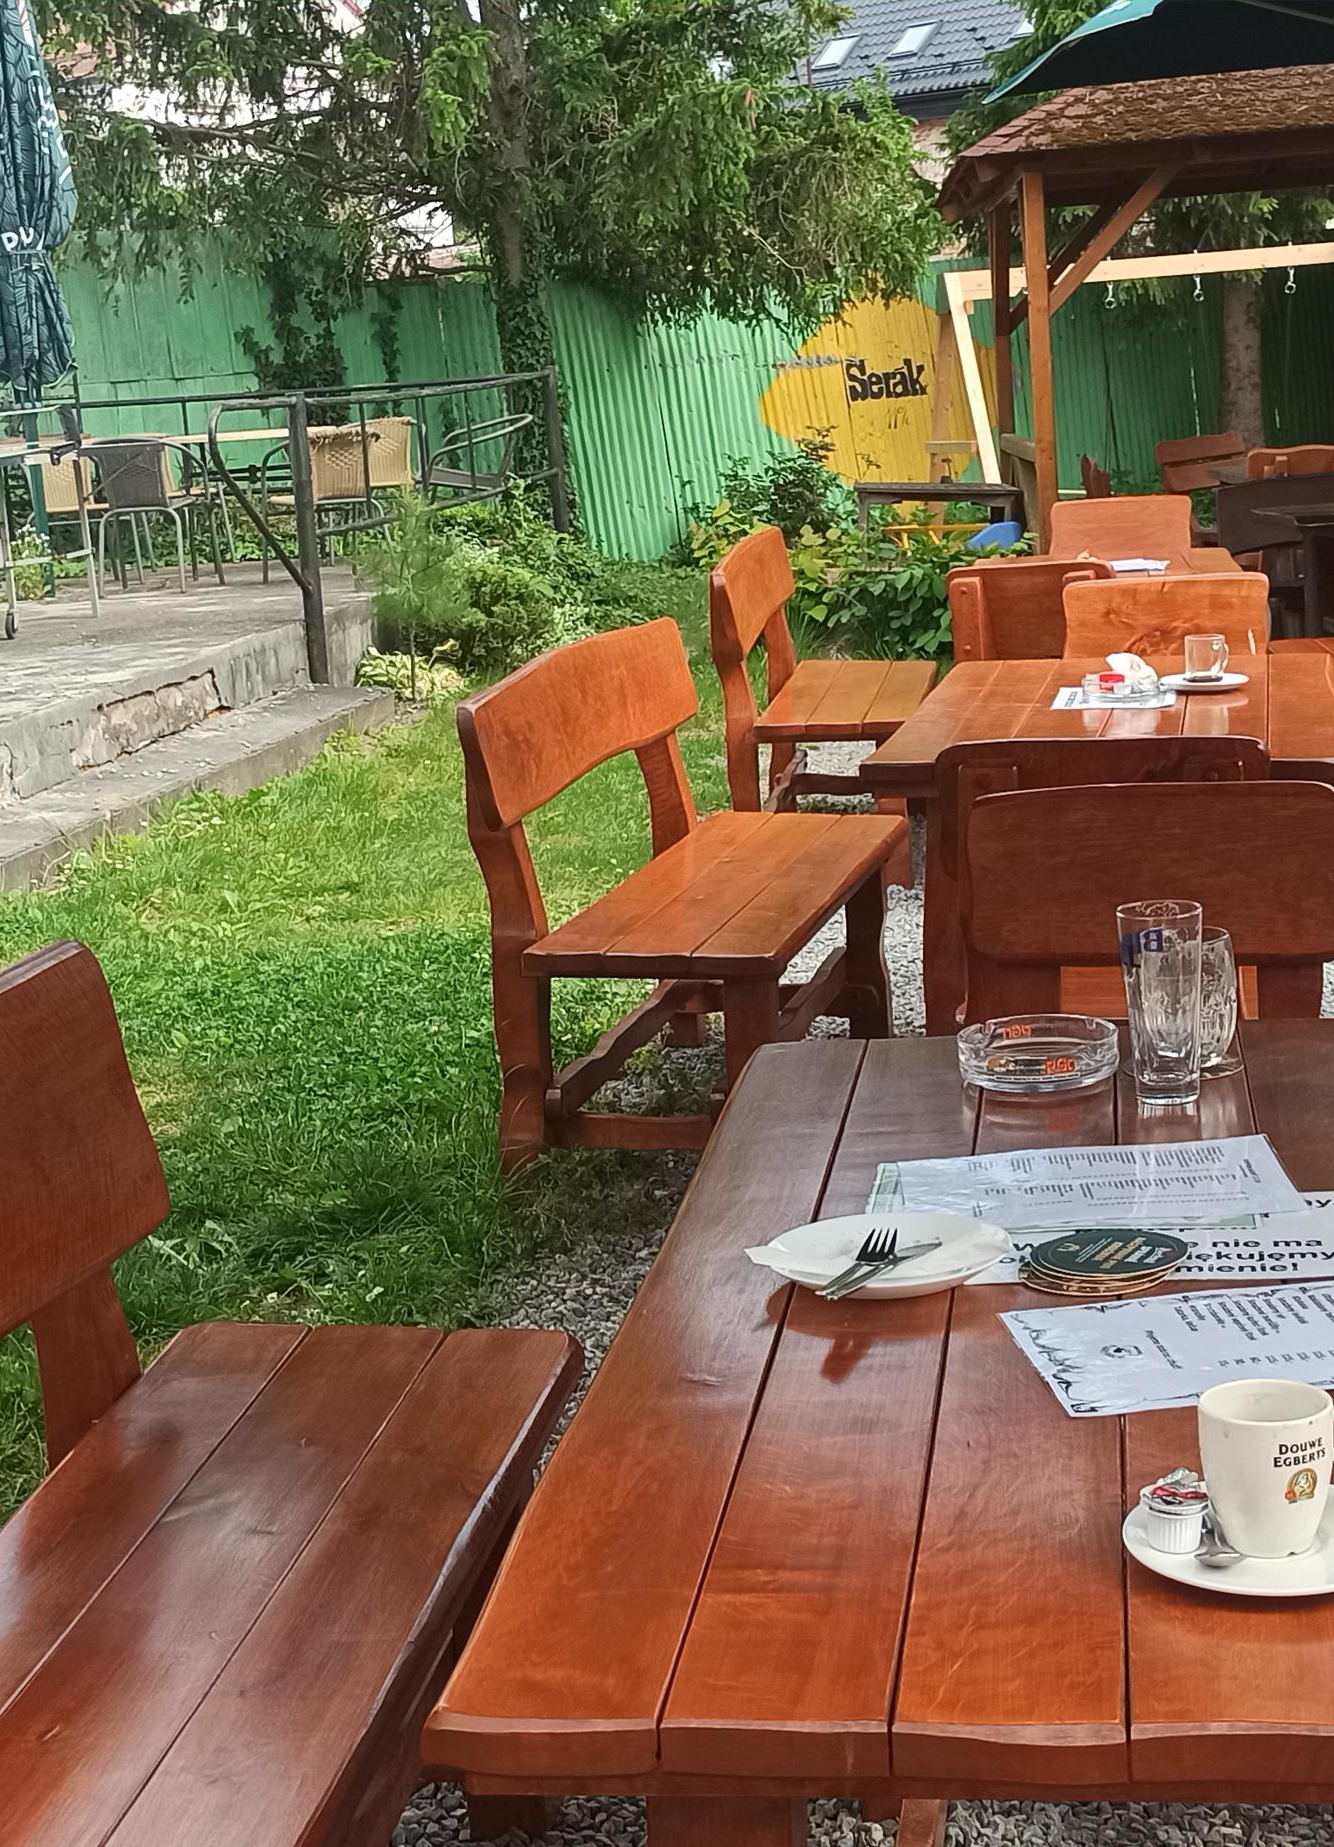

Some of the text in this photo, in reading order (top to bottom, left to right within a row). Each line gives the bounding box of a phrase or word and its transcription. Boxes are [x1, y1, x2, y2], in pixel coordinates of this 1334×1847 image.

[1211, 1239, 1262, 1249] nie
[1272, 1239, 1323, 1249] ma
[1174, 1262, 1299, 1273] mienie!
[1278, 1436, 1324, 1456] DOUWE
[1272, 1447, 1327, 1469] EGBERTS
